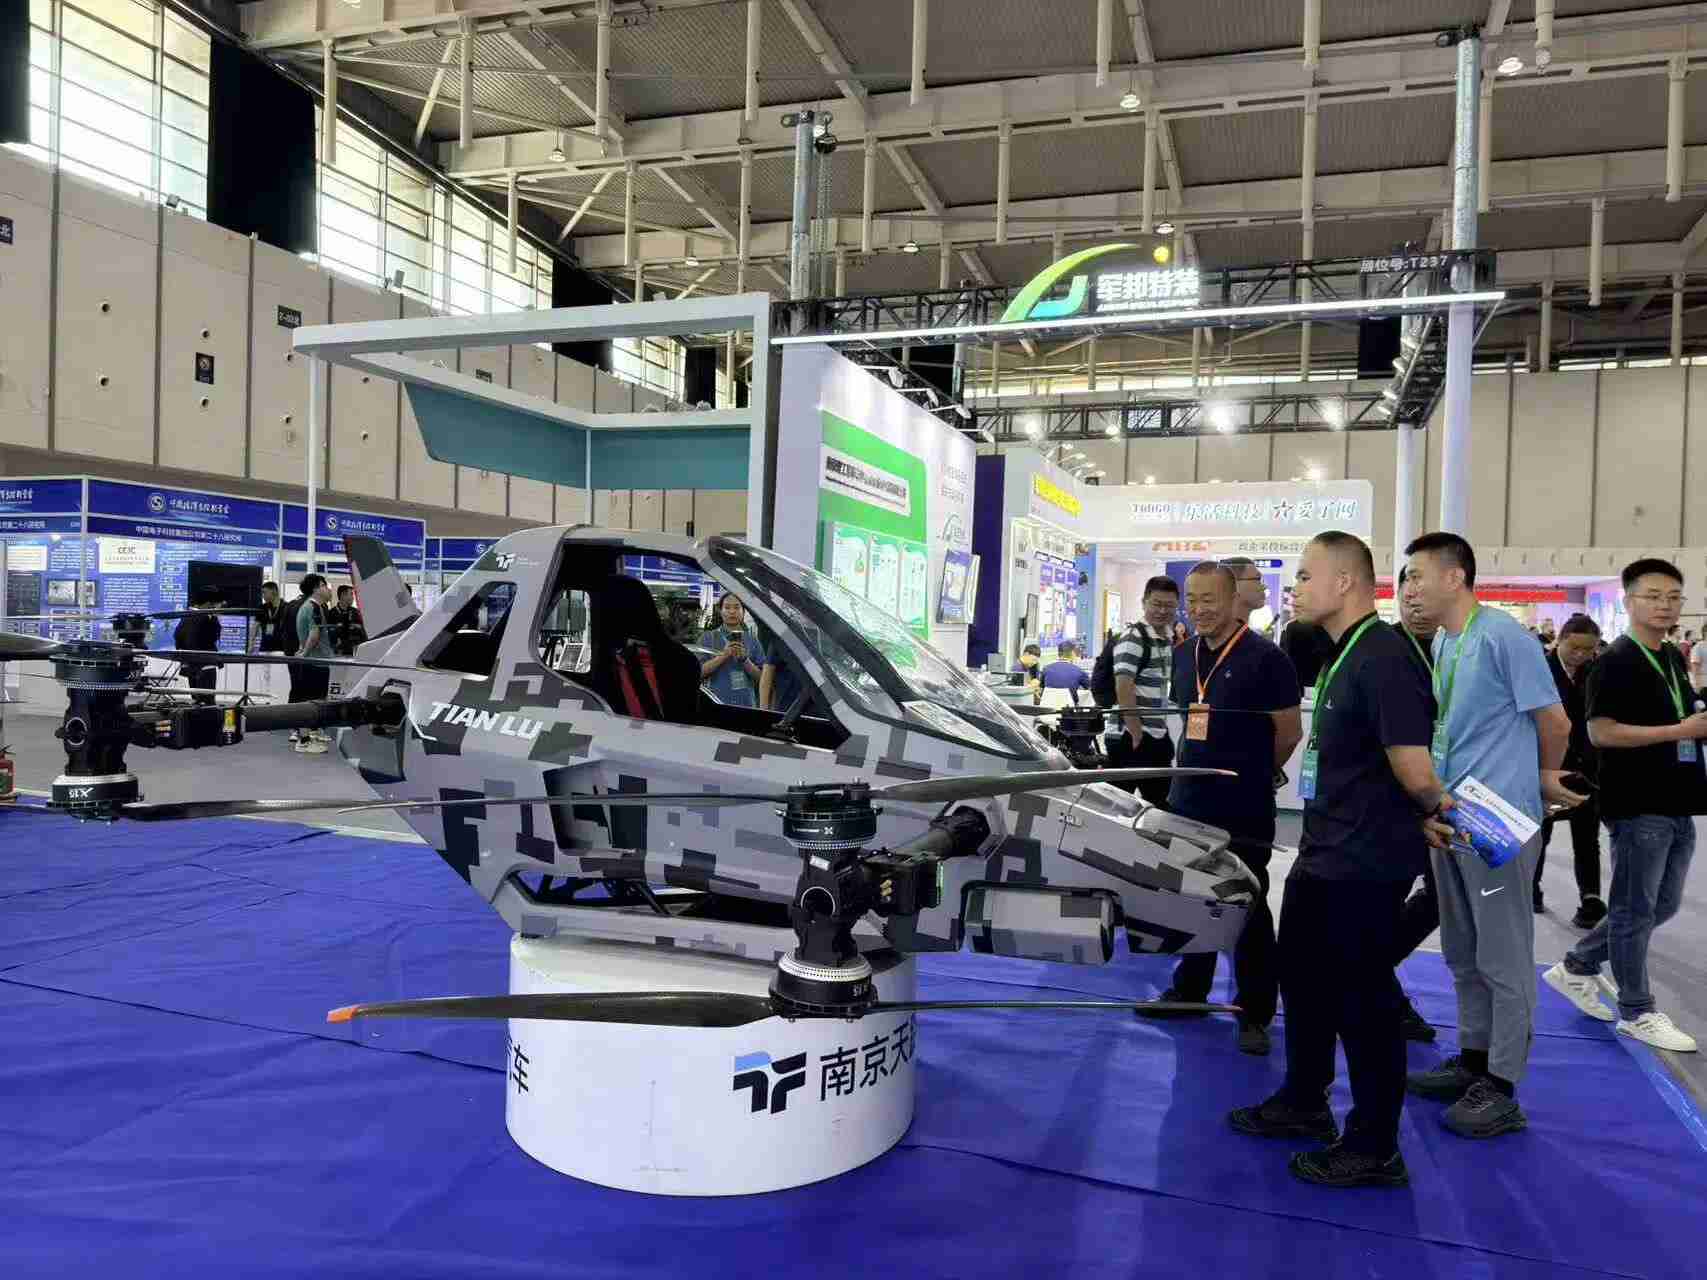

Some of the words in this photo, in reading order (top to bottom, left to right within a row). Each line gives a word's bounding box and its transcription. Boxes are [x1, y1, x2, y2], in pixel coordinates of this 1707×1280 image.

[429, 702, 500, 732] TIAN
[500, 715, 544, 740] LU
[820, 1020, 914, 1101] 南京天
